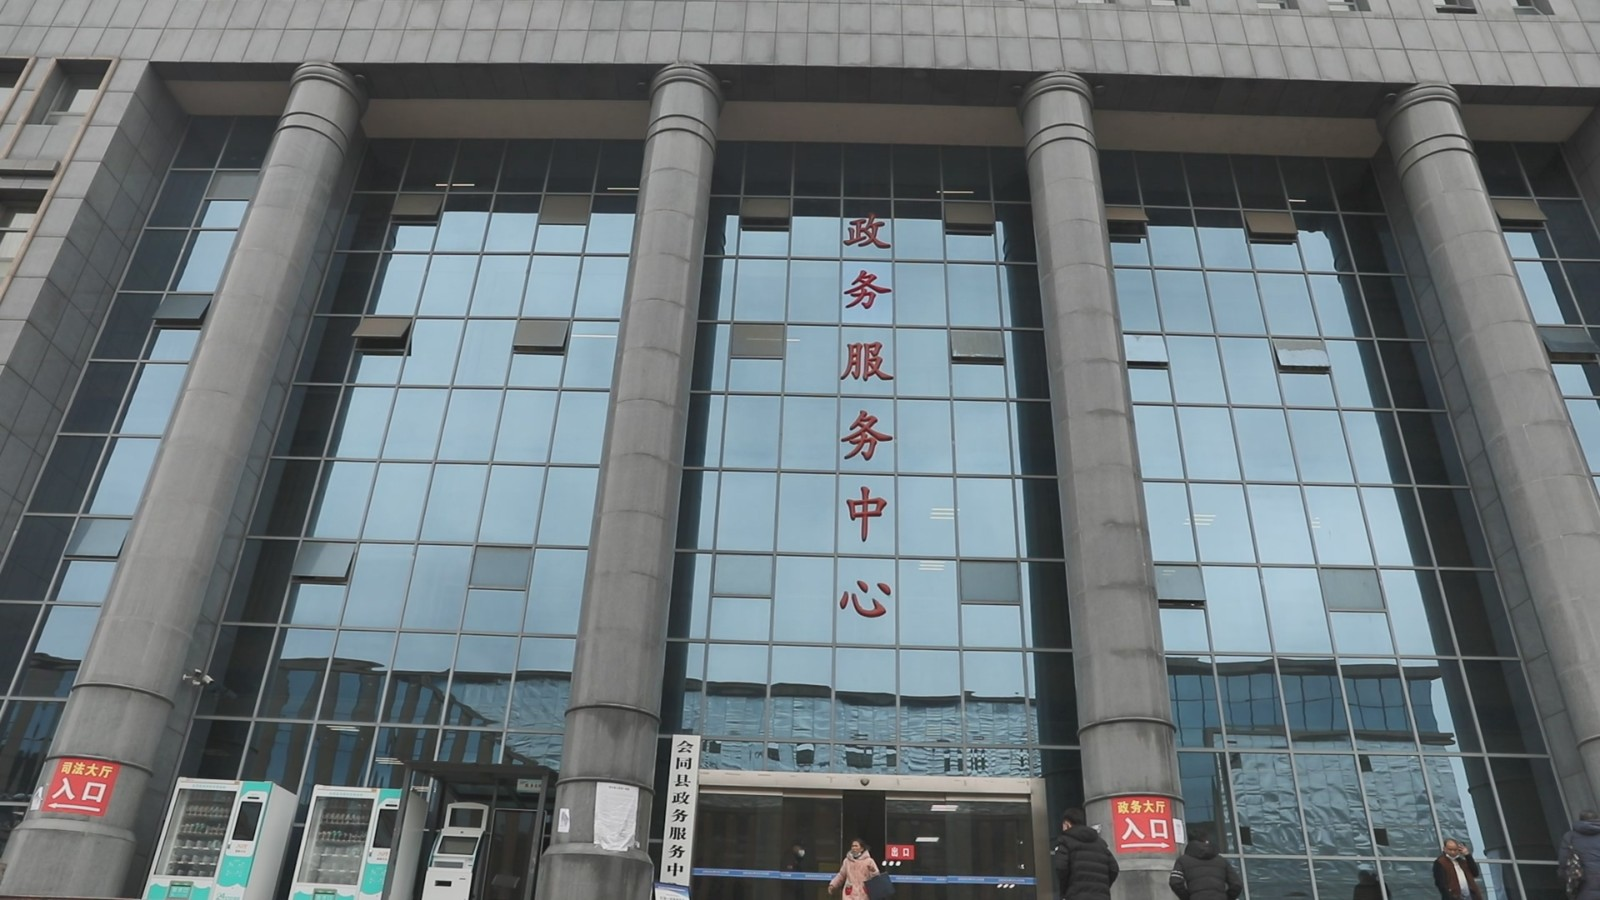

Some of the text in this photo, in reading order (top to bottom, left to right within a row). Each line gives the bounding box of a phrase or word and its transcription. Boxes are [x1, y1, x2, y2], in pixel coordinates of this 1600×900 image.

[840, 214, 894, 618] 政务服务中心
[60, 761, 113, 779] 司法大厅
[52, 778, 106, 803] 入口
[667, 740, 694, 881] 会同县政务服务中
[1117, 800, 1165, 814] 政务大厅
[1121, 818, 1168, 841] 入口
[891, 846, 910, 858] 出口
